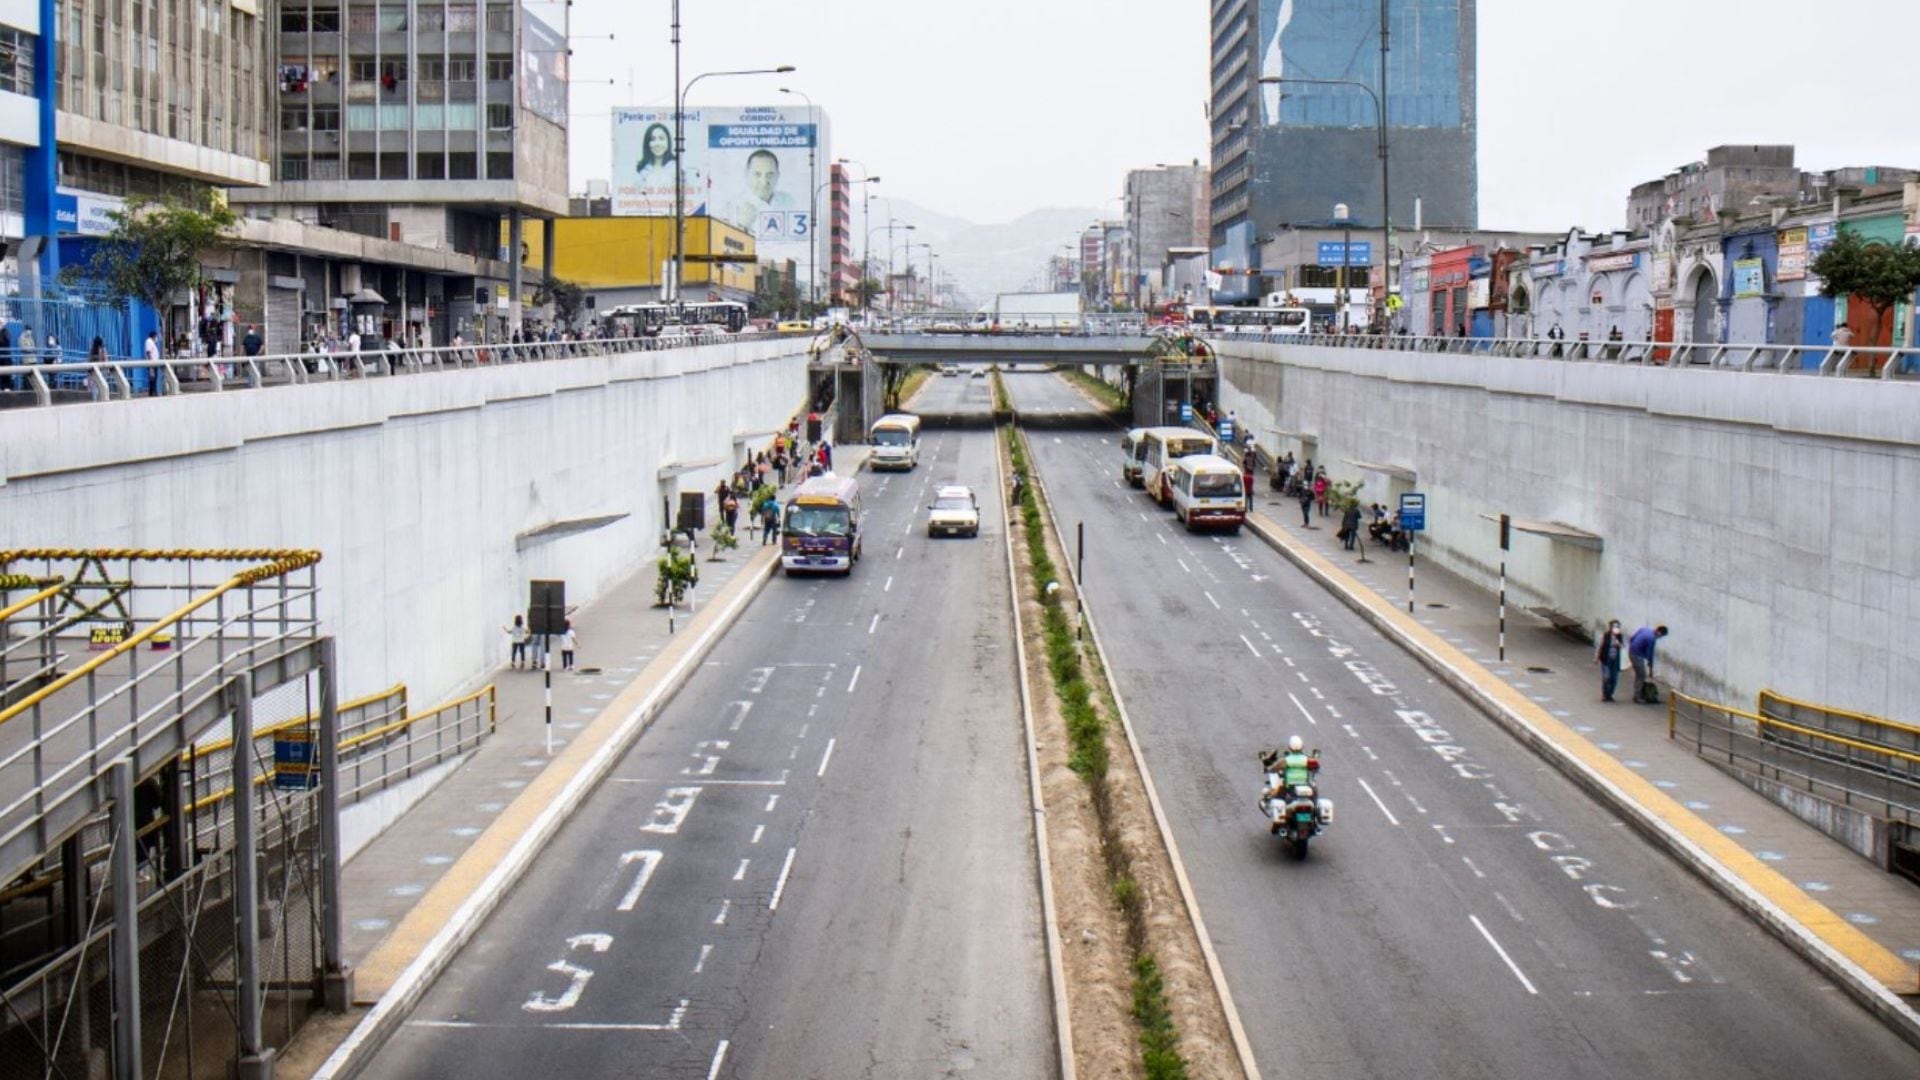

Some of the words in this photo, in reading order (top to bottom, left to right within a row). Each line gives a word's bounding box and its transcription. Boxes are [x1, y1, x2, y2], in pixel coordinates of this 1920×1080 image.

[728, 127, 782, 135] IGUALDAD
[784, 127, 798, 135] DE
[719, 137, 808, 145] OPORTUNIDADES
[794, 214, 807, 235] 3
